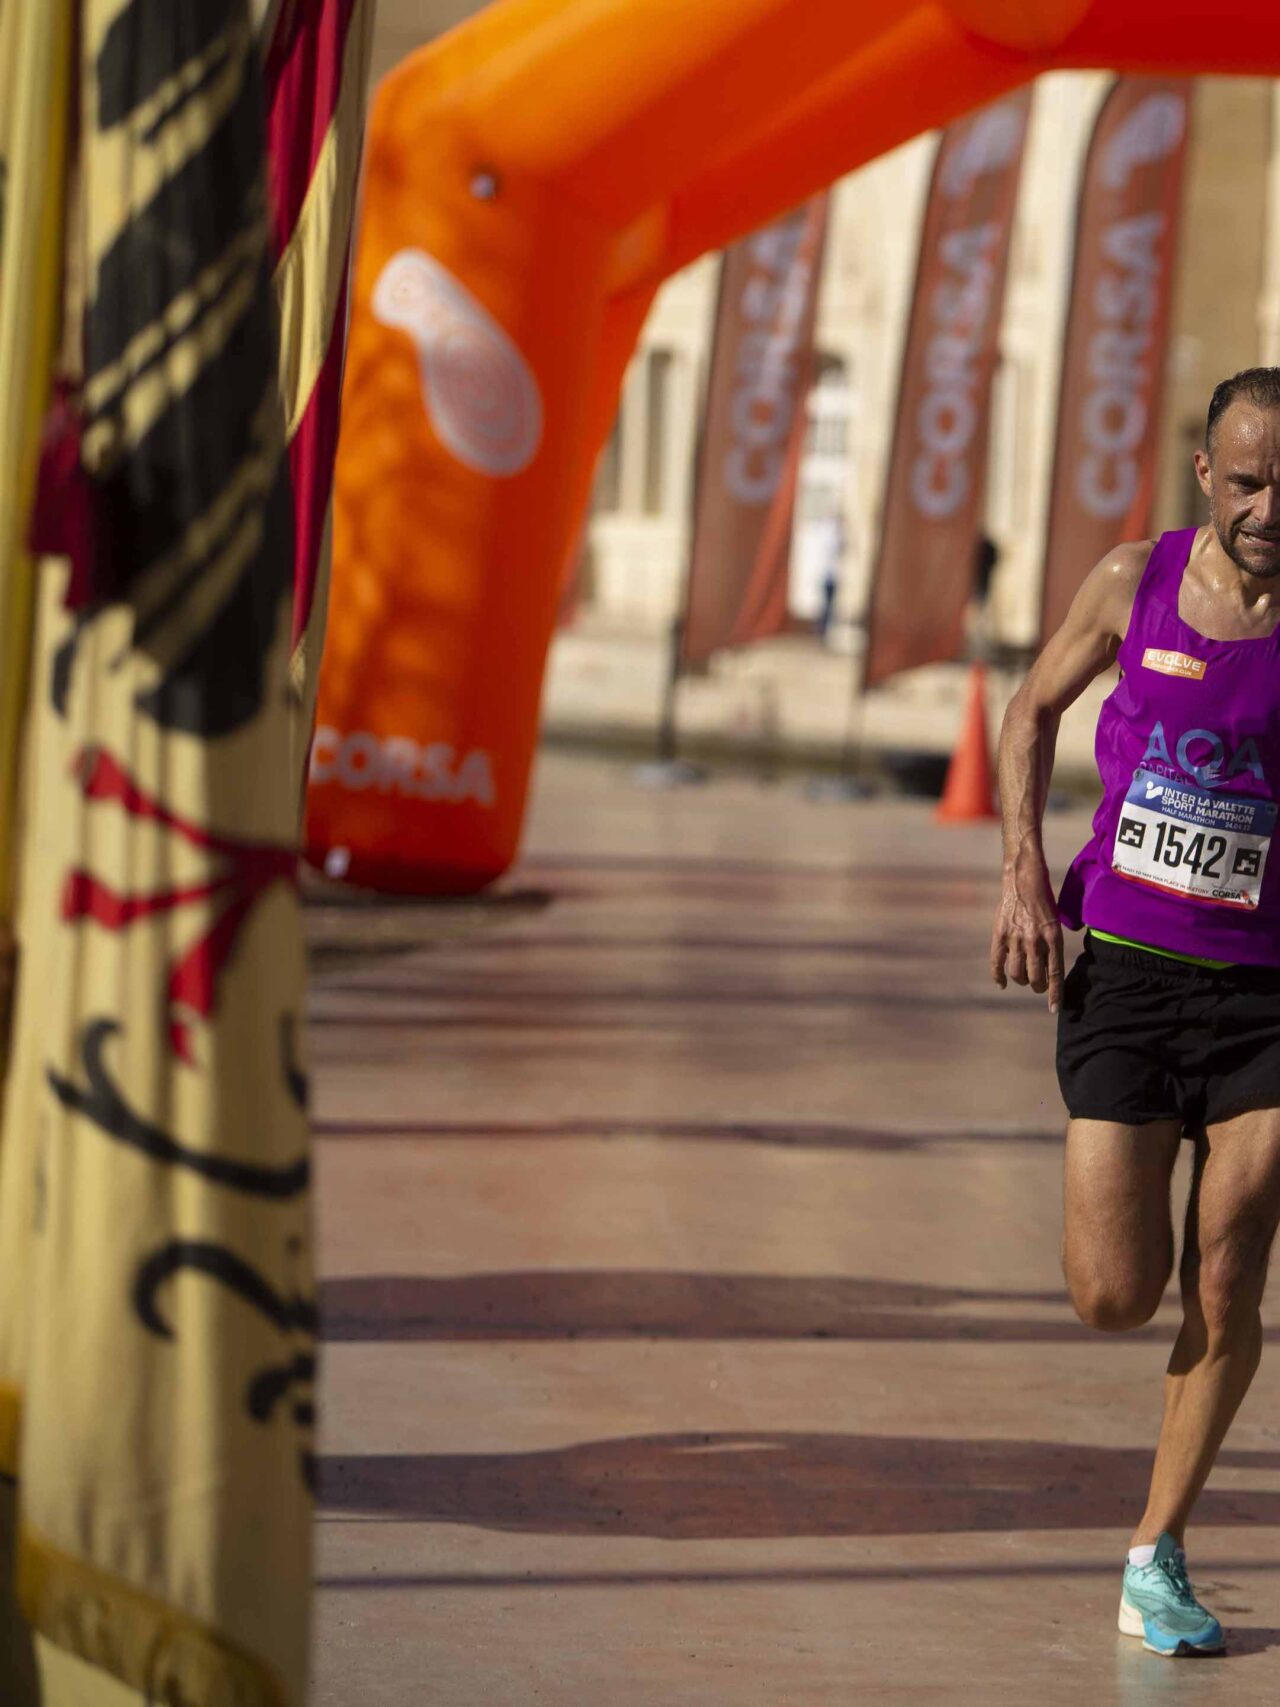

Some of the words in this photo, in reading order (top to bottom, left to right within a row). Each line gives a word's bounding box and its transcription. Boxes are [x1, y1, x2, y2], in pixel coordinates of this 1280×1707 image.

[911, 223, 1001, 518] CORSA
[1080, 210, 1165, 518] CORSA
[1147, 650, 1202, 672] EVOLVE
[308, 723, 494, 807] CORSA
[1141, 719, 1265, 788] AQA
[1161, 795, 1195, 813] SPORT
[1195, 806, 1254, 825] MARATHON
[1161, 806, 1178, 815] HALF
[1178, 811, 1216, 826] MARATHON
[1164, 786, 1196, 805] INTER
[1197, 796, 1211, 807] LA
[1212, 800, 1256, 816] VALETTE
[1152, 820, 1228, 880] 1542
[1211, 889, 1241, 900] CORSA
